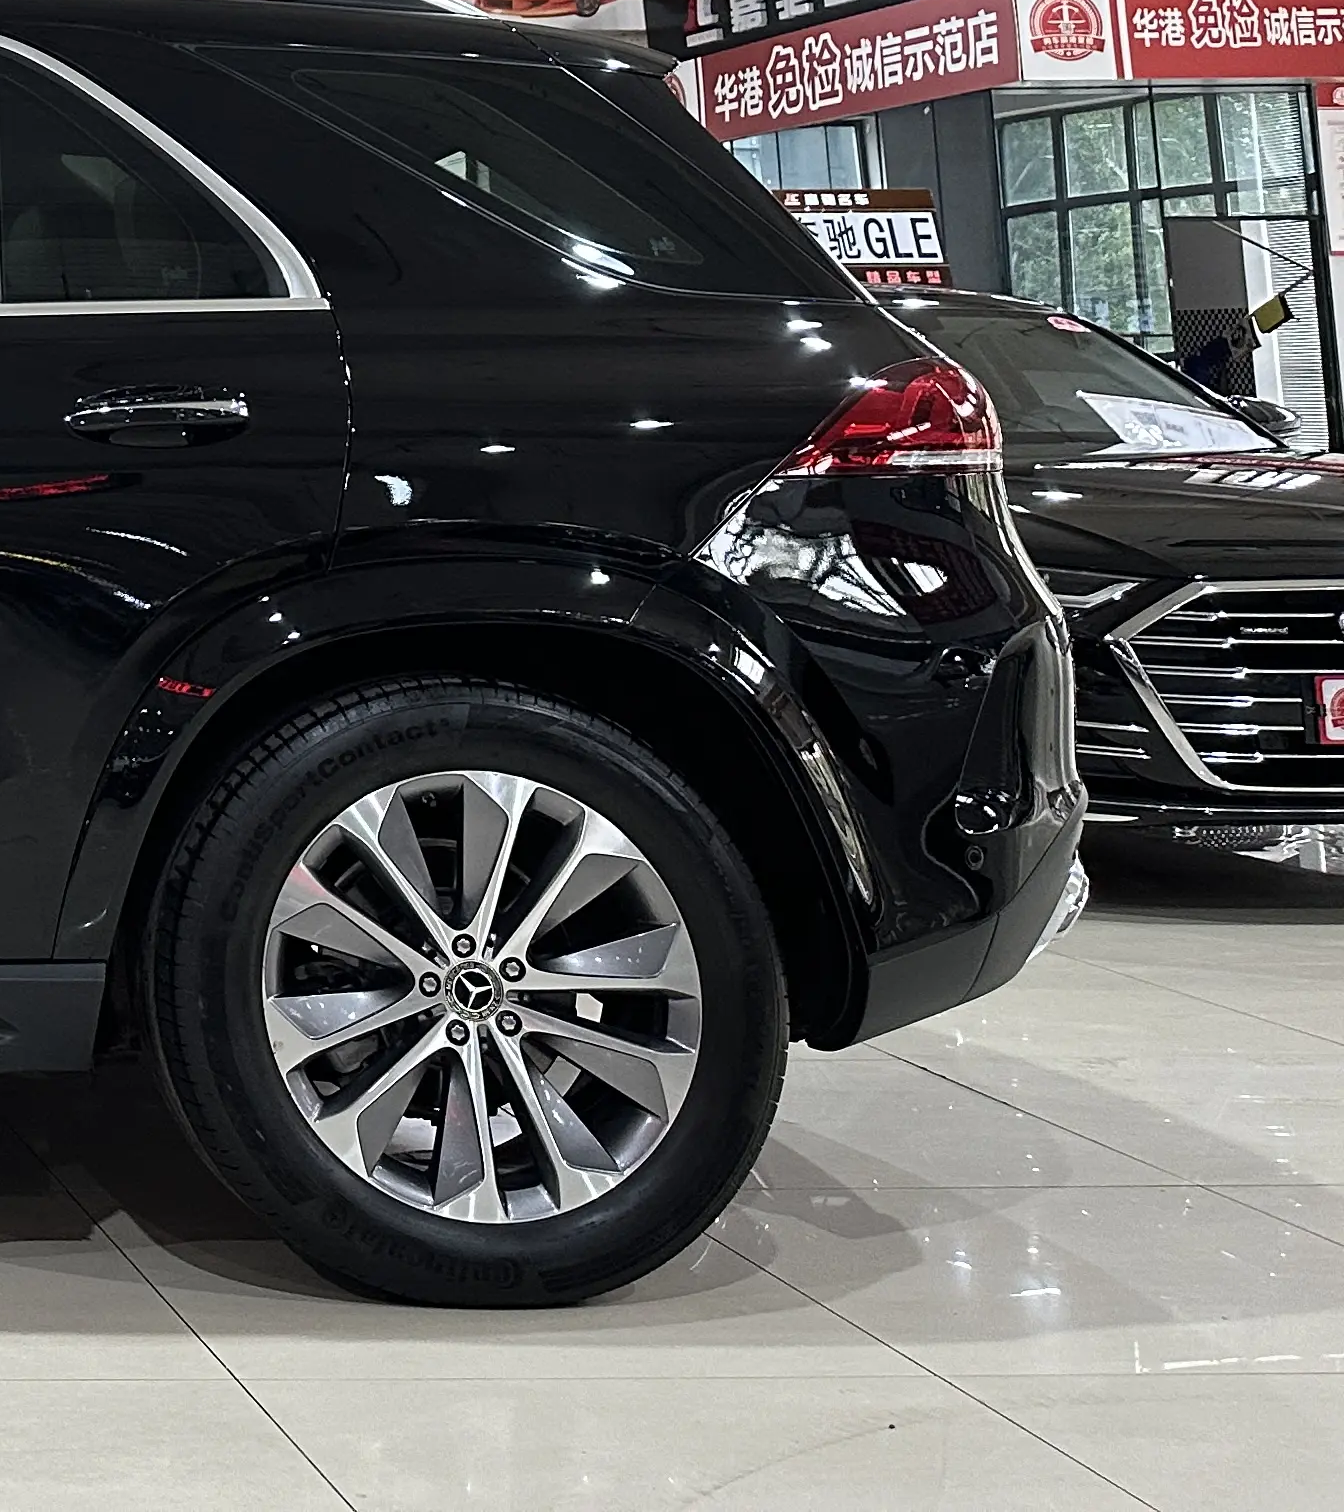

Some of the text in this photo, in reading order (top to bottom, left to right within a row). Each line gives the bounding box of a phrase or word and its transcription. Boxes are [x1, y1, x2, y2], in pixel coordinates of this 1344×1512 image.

[713, 8, 1000, 123] 华港免检诚信示范店
